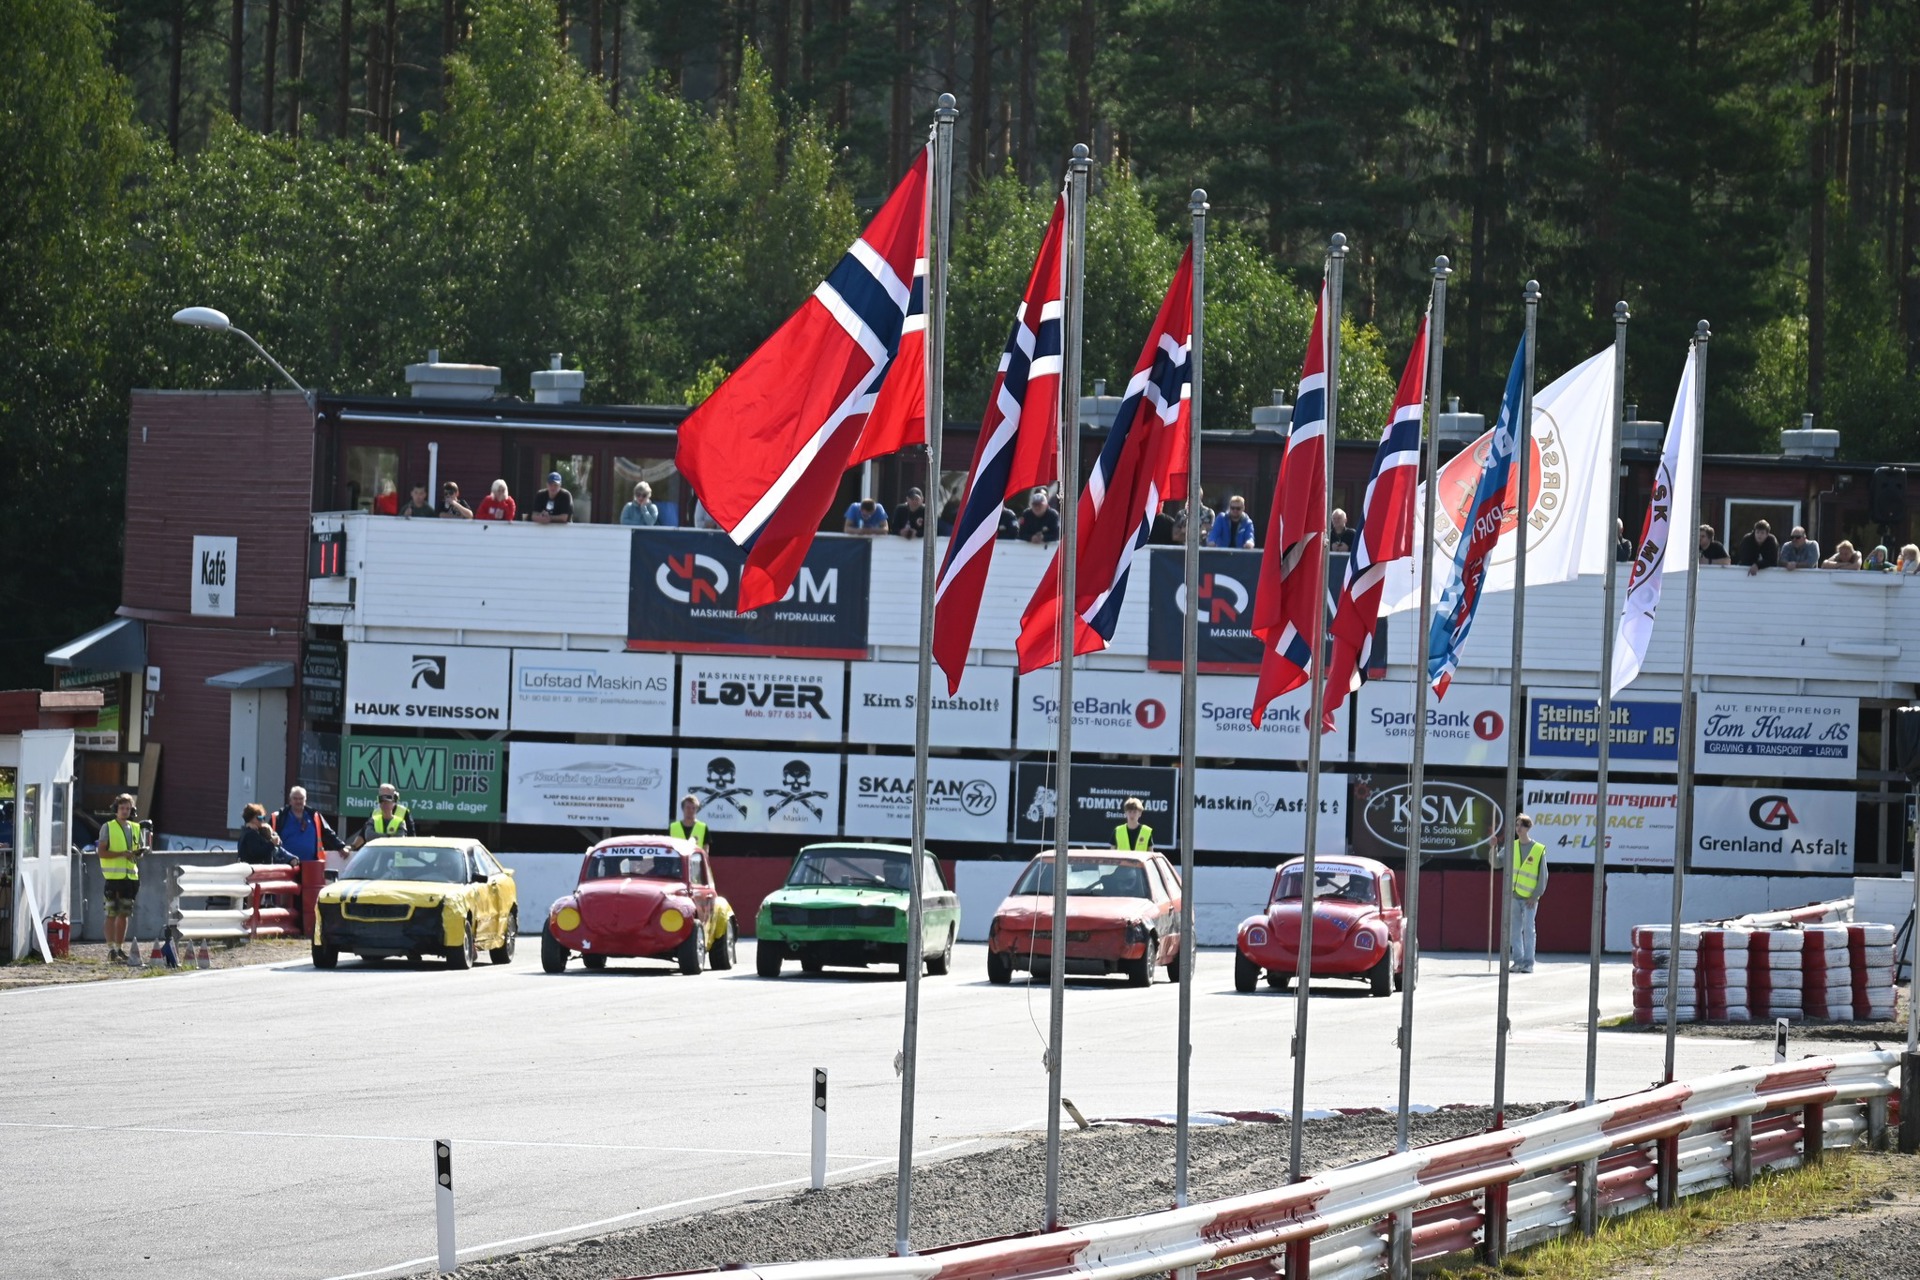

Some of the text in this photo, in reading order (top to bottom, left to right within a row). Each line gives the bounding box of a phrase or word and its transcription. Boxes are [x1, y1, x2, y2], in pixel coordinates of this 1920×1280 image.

[318, 533, 332, 543] HEAT
[320, 543, 338, 574] 11
[201, 550, 226, 586] Kafé
[775, 612, 836, 623] HYDRAULIKK
[524, 672, 668, 692] Lofstad Maskin AS
[699, 672, 823, 684] MASKINENTREPRENØR
[698, 681, 832, 720] LØVER
[863, 693, 991, 712] Kim Sinsholt
[1033, 695, 1132, 715] SpeBank
[354, 703, 499, 720] HAUK SVEINSSON
[745, 709, 813, 719] Mob. 977 65 334
[1715, 704, 1841, 716] AUT. ENTREPRENØR
[1047, 716, 1132, 728] SØØST-NORGE
[1703, 714, 1851, 741] Tom Hvaal AS
[1385, 728, 1470, 739] SØRØT-NORGE
[1653, 727, 1675, 745] AS
[1709, 743, 1744, 754] GRAVING
[1746, 745, 1753, 754] &
[1756, 744, 1804, 756] TRANSPORT
[1815, 746, 1844, 757] LARVIK
[348, 744, 495, 792] KIWI mini
[452, 771, 489, 797] pris
[411, 799, 433, 810] 7-23
[435, 800, 455, 811] alle
[456, 801, 488, 814] dager
[881, 796, 940, 805] MASIN
[1078, 797, 1123, 810] TOMMY
[1193, 794, 1251, 811] Maskin
[1274, 797, 1327, 814] Asft
[1527, 789, 1678, 809] pixelmoorsport
[707, 812, 733, 820] Maskin
[792, 806, 799, 814] N
[1391, 794, 1476, 825] KSM
[783, 814, 809, 823] Maskin
[1534, 812, 1582, 827] READY
[1607, 815, 1645, 829] RACE
[1433, 826, 1472, 835] Solbakken
[1420, 835, 1456, 846] skinering
[1699, 835, 1848, 855] Grenland Asfalt
[611, 847, 661, 856] NMK GOL
